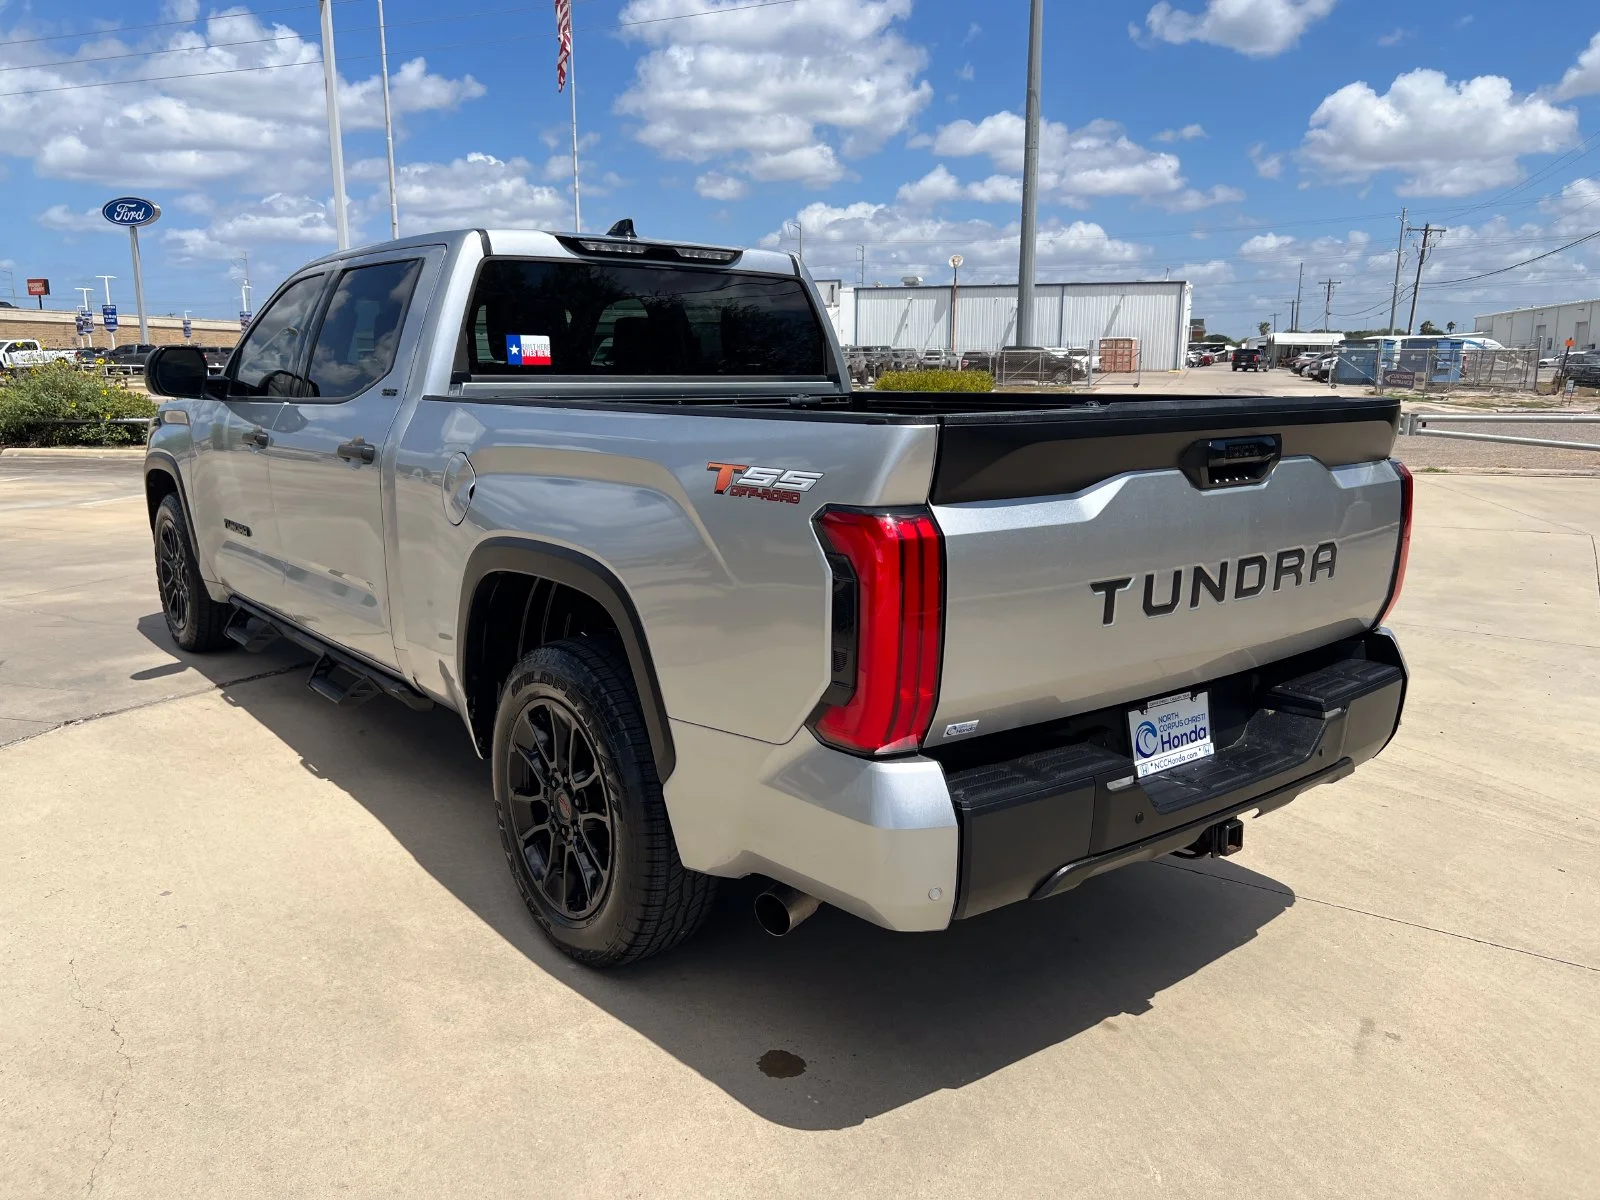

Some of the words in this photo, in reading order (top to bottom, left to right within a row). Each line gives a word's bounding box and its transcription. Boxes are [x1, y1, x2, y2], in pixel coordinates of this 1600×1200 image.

[114, 203, 145, 220] Ford
[1088, 539, 1338, 627] TUNDRA
[1158, 712, 1179, 724] NORTH
[1158, 720, 1184, 733] CORPUS
[1184, 712, 1206, 726] CHRISTI
[1160, 724, 1207, 752] Honda
[1154, 752, 1198, 770] NCCHonda.com
